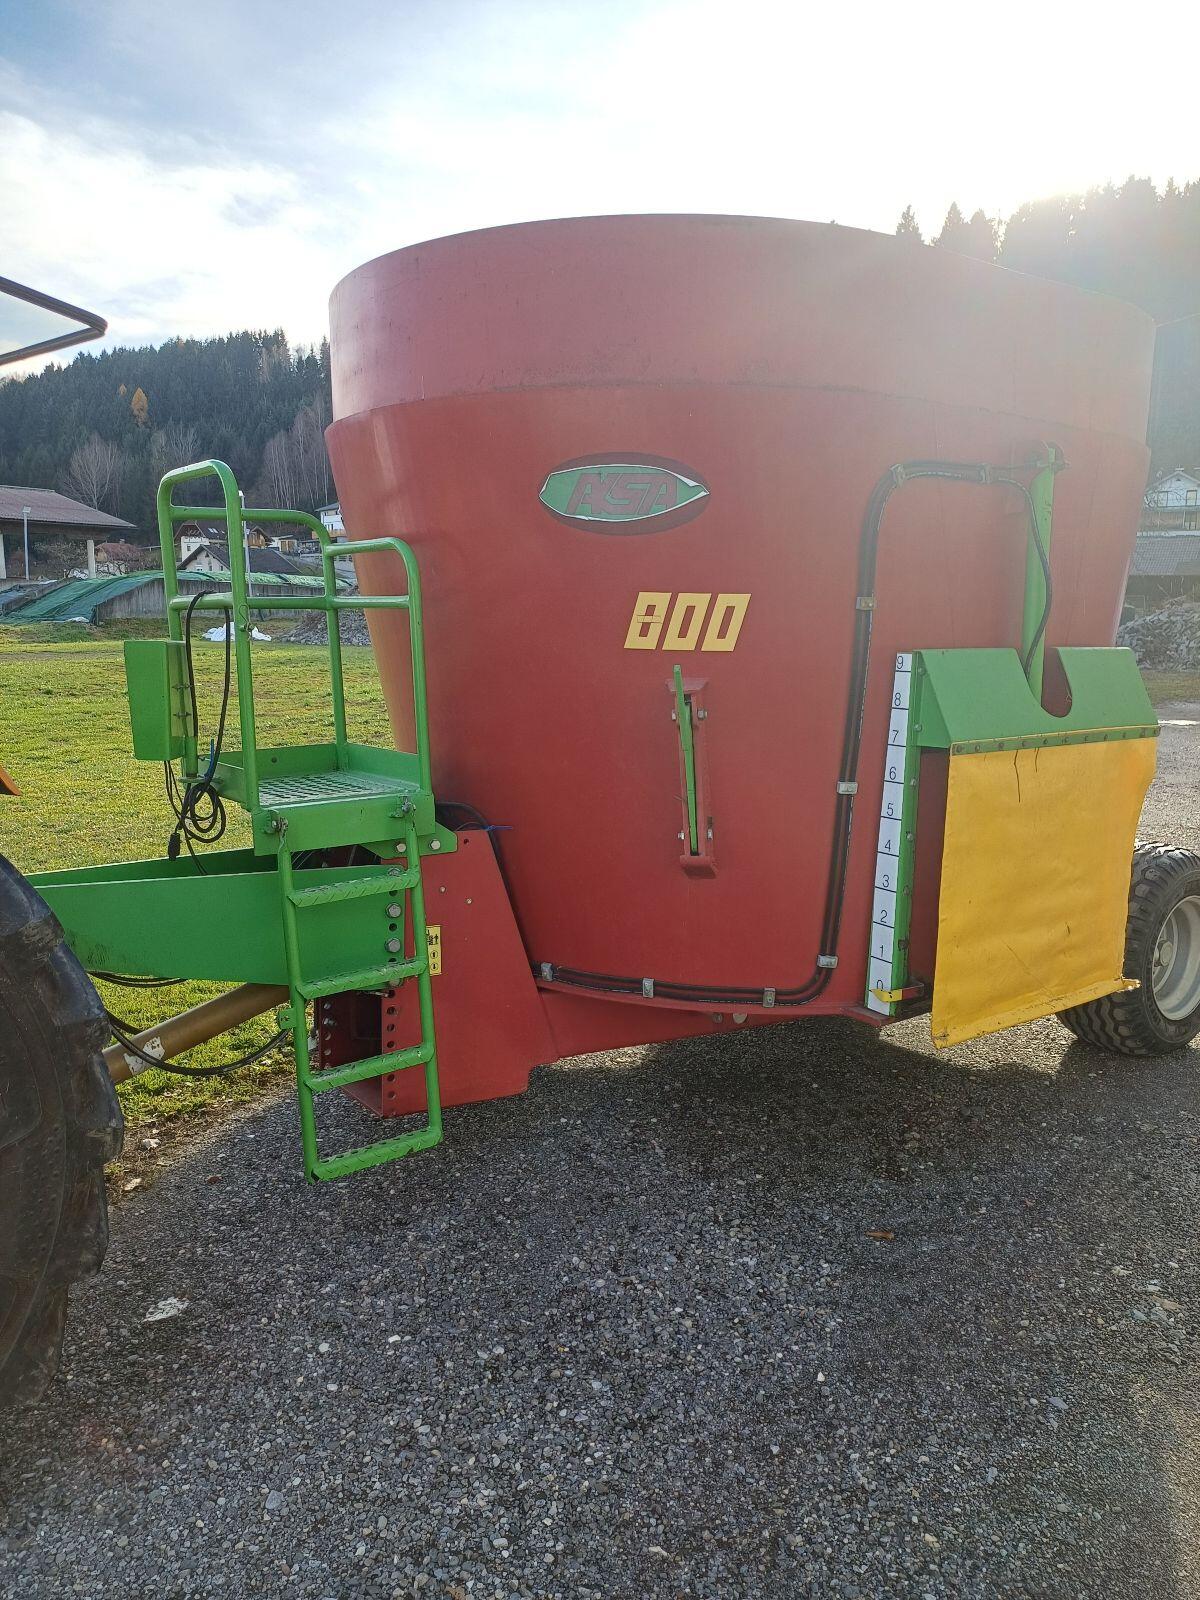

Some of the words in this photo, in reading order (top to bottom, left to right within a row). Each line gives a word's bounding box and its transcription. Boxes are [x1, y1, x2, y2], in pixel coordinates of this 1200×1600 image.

[623, 592, 752, 652] 800
[896, 655, 904, 670] 9
[894, 692, 901, 707] 8
[892, 729, 899, 743] 7
[889, 766, 897, 781] 6
[886, 802, 894, 817] 5
[884, 839, 892, 852] 4
[882, 874, 890, 888] 3
[880, 909, 888, 924] 2
[879, 944, 884, 957] 1
